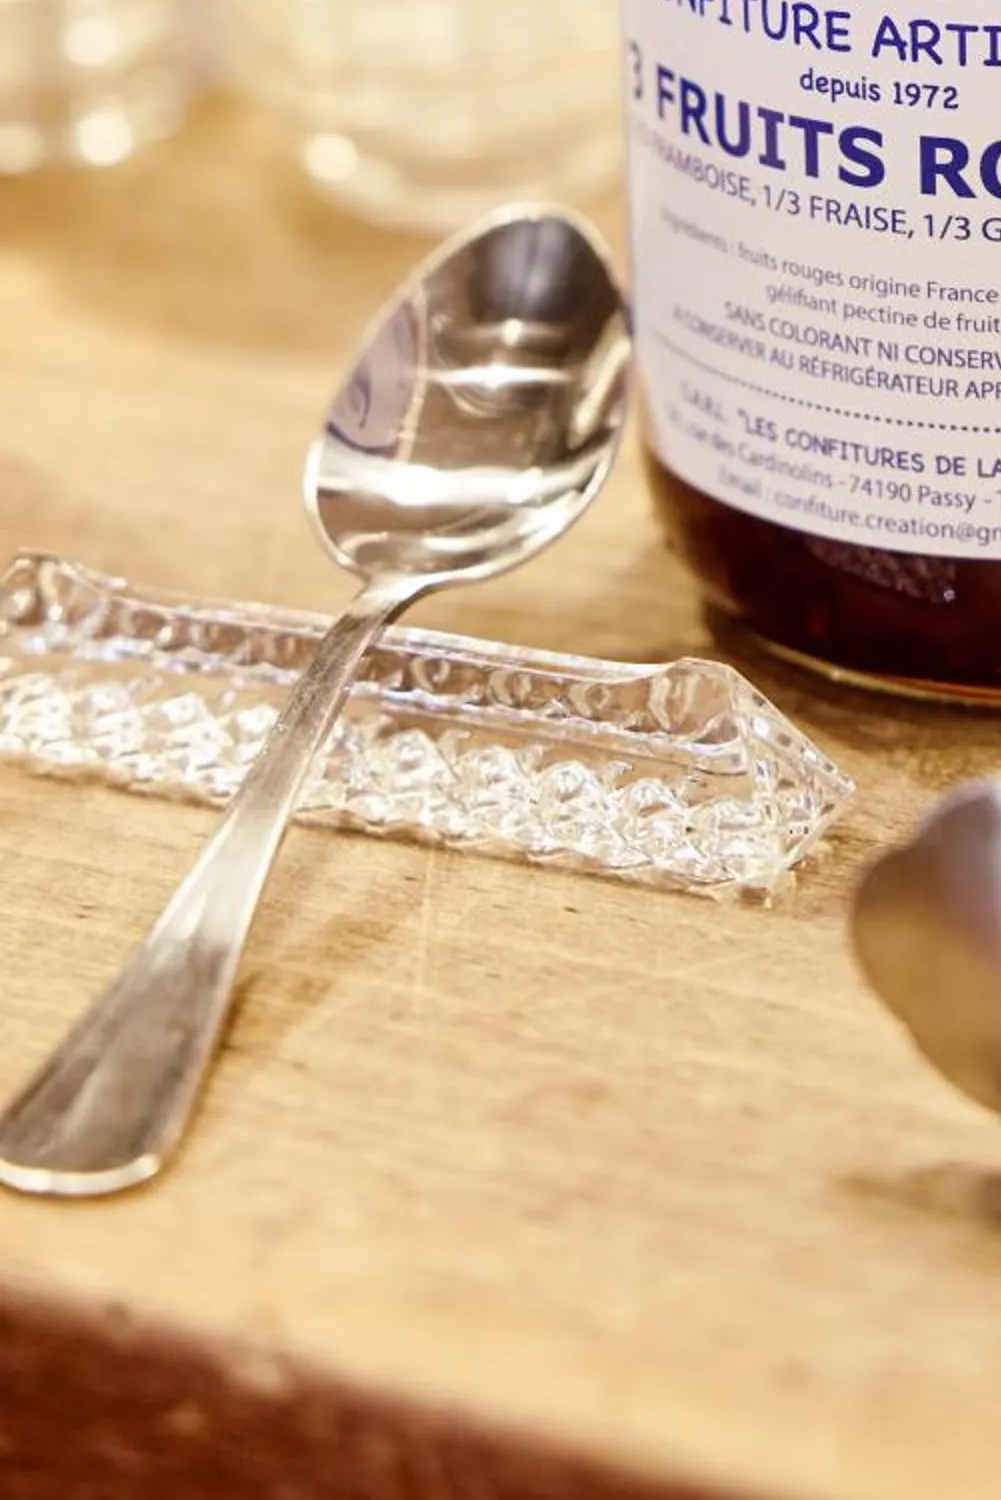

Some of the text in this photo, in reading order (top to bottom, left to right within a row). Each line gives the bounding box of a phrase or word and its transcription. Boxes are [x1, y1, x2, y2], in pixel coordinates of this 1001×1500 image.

[800, 68, 960, 109] depuis 1972
[656, 64, 886, 188] FRUITS
[654, 134, 756, 207] AMBOISE,
[763, 185, 801, 215] 1/3
[810, 196, 914, 239] FRAISE,
[924, 213, 971, 240] 1/3
[766, 284, 837, 315] gélifiant
[843, 303, 919, 328] pectine
[924, 311, 951, 330] de
[782, 260, 844, 287] rouges
[849, 273, 921, 298] origine
[927, 280, 999, 304] France
[724, 300, 766, 332] SANS
[769, 317, 872, 357] COLORANT
[878, 343, 898, 362] NI
[769, 348, 794, 370] AU
[800, 355, 959, 398] RÉFRIGÉRATEUR
[785, 427, 925, 474] CONFITURES
[936, 455, 966, 477] DE
[850, 475, 912, 501] 74190
[918, 485, 976, 513] Passy
